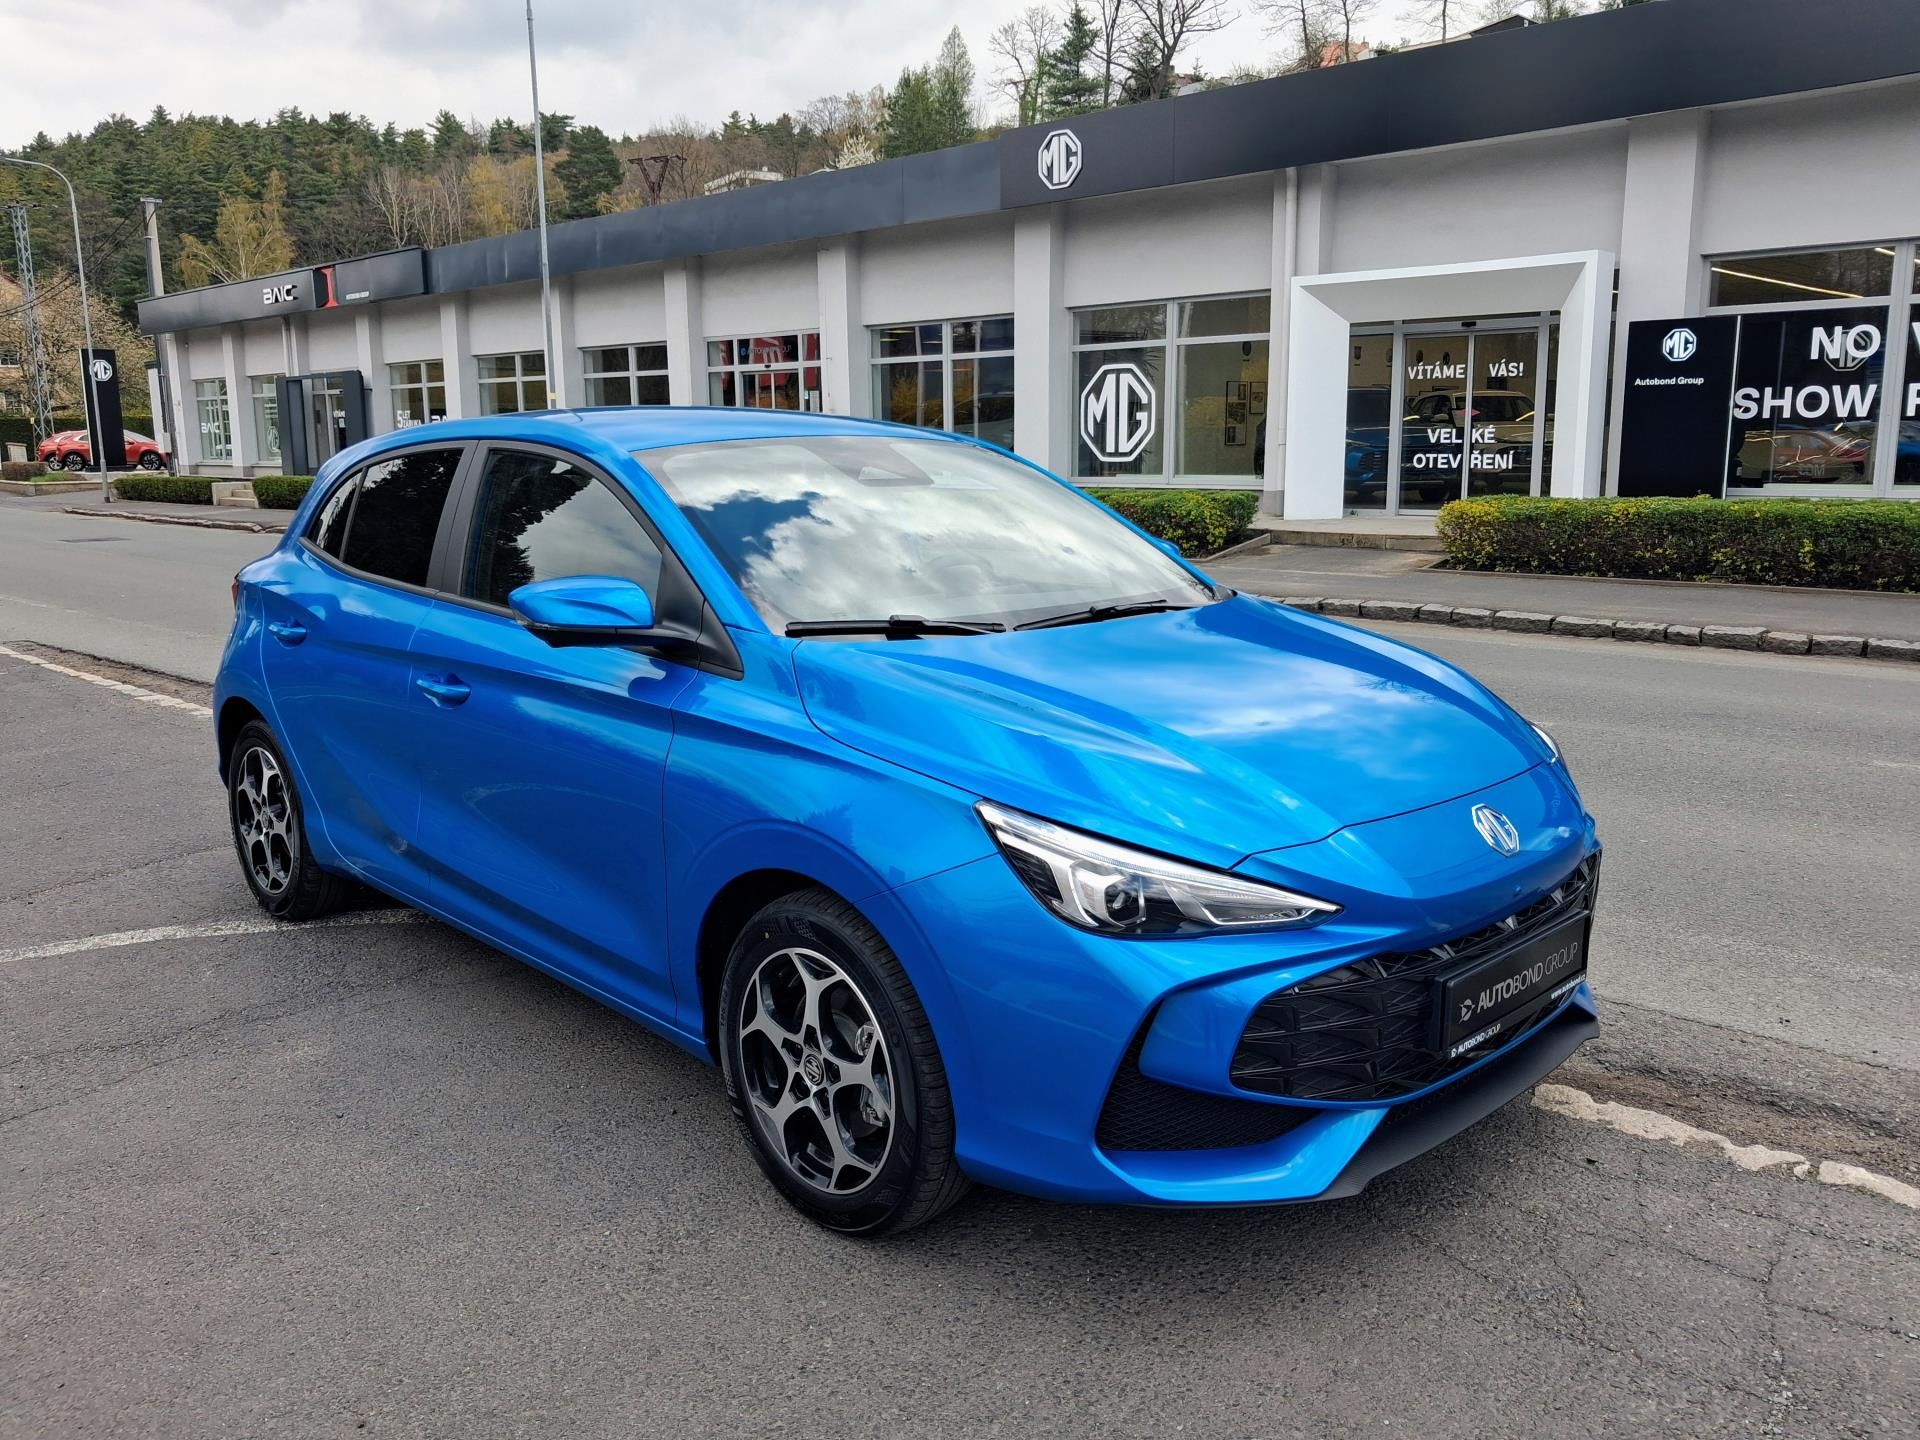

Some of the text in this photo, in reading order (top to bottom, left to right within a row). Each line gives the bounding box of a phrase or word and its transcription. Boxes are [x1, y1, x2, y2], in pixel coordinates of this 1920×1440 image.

[1041, 134, 1078, 185] MG
[262, 284, 295, 305] BAIC
[1667, 330, 1695, 359] MG
[92, 360, 112, 380] MG
[1408, 358, 1524, 380] VÍTÁME VÁS!
[1634, 376, 1705, 386] Autobond Group
[1086, 372, 1150, 454] MG
[1412, 450, 1514, 470] OTEVŘENÍ
[1476, 806, 1517, 852] MG
[1477, 942, 1578, 1014] AUTOBOND GROUP
[1457, 1032, 1485, 1055] AUTOBOND
